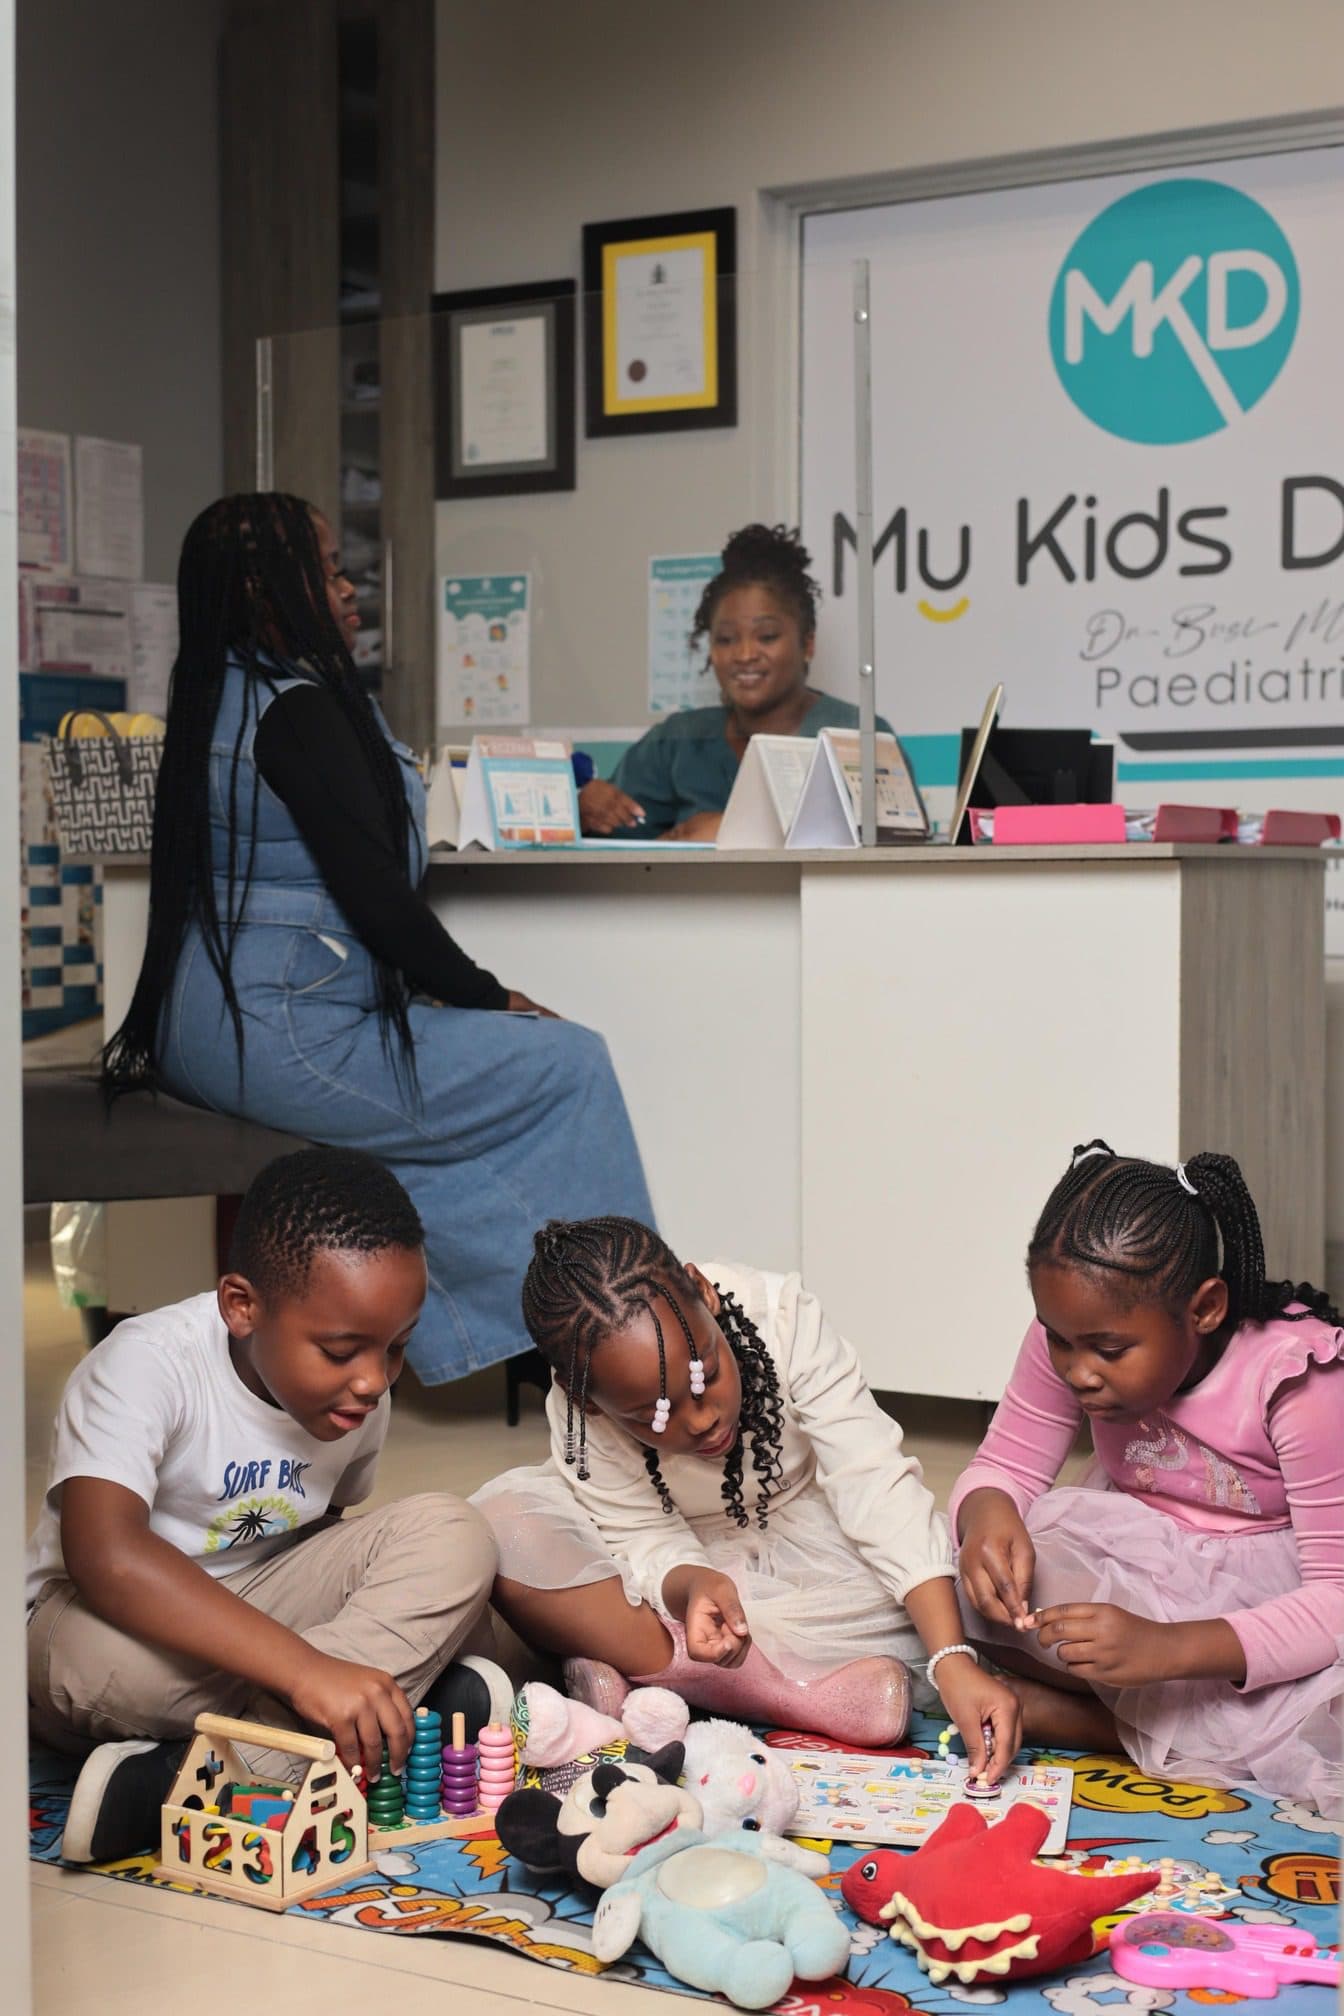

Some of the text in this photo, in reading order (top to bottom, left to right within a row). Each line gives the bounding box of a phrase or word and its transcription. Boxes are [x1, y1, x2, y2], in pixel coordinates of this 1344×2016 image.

[1064, 248, 1289, 425] MKD
[1016, 486, 1232, 587] Kids
[217, 1459, 272, 1501] SURF
[1074, 1768, 1208, 1806] POW
